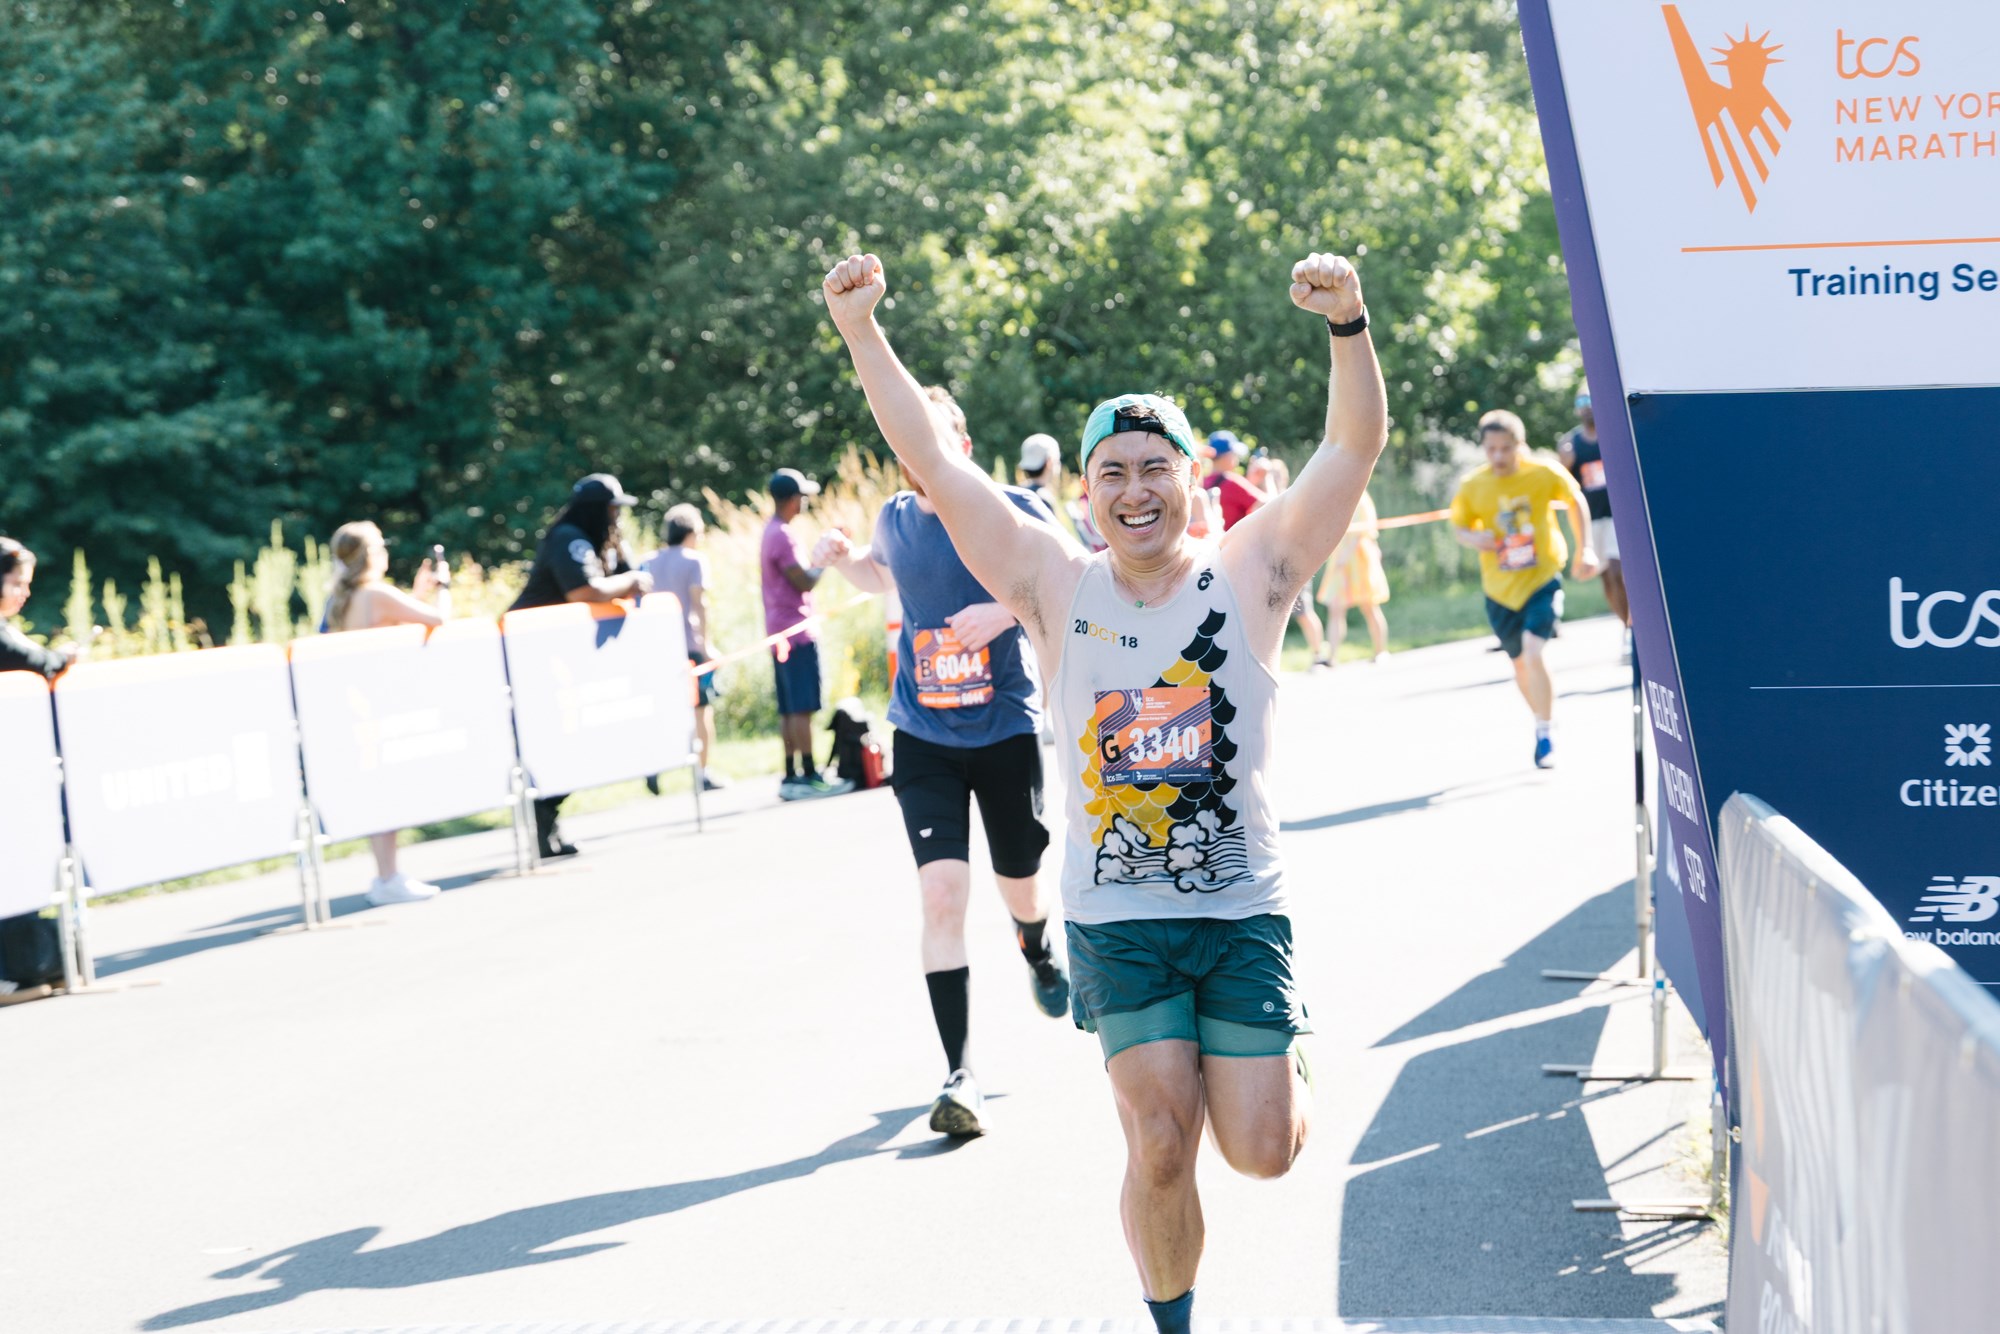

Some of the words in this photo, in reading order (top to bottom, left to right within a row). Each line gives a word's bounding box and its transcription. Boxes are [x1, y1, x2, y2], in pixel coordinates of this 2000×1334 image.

[1836, 28, 1921, 80] tcs
[1836, 95, 1922, 124] NEW
[1836, 130, 1996, 162] MARATH
[1788, 264, 1939, 301] Training
[1952, 262, 1999, 292] Se
[1889, 576, 2000, 649] tcs
[920, 659, 931, 678] B
[935, 653, 985, 681] 6044
[1101, 733, 1121, 764] G
[1128, 725, 1200, 763] 3340
[1899, 778, 2000, 807] Citize
